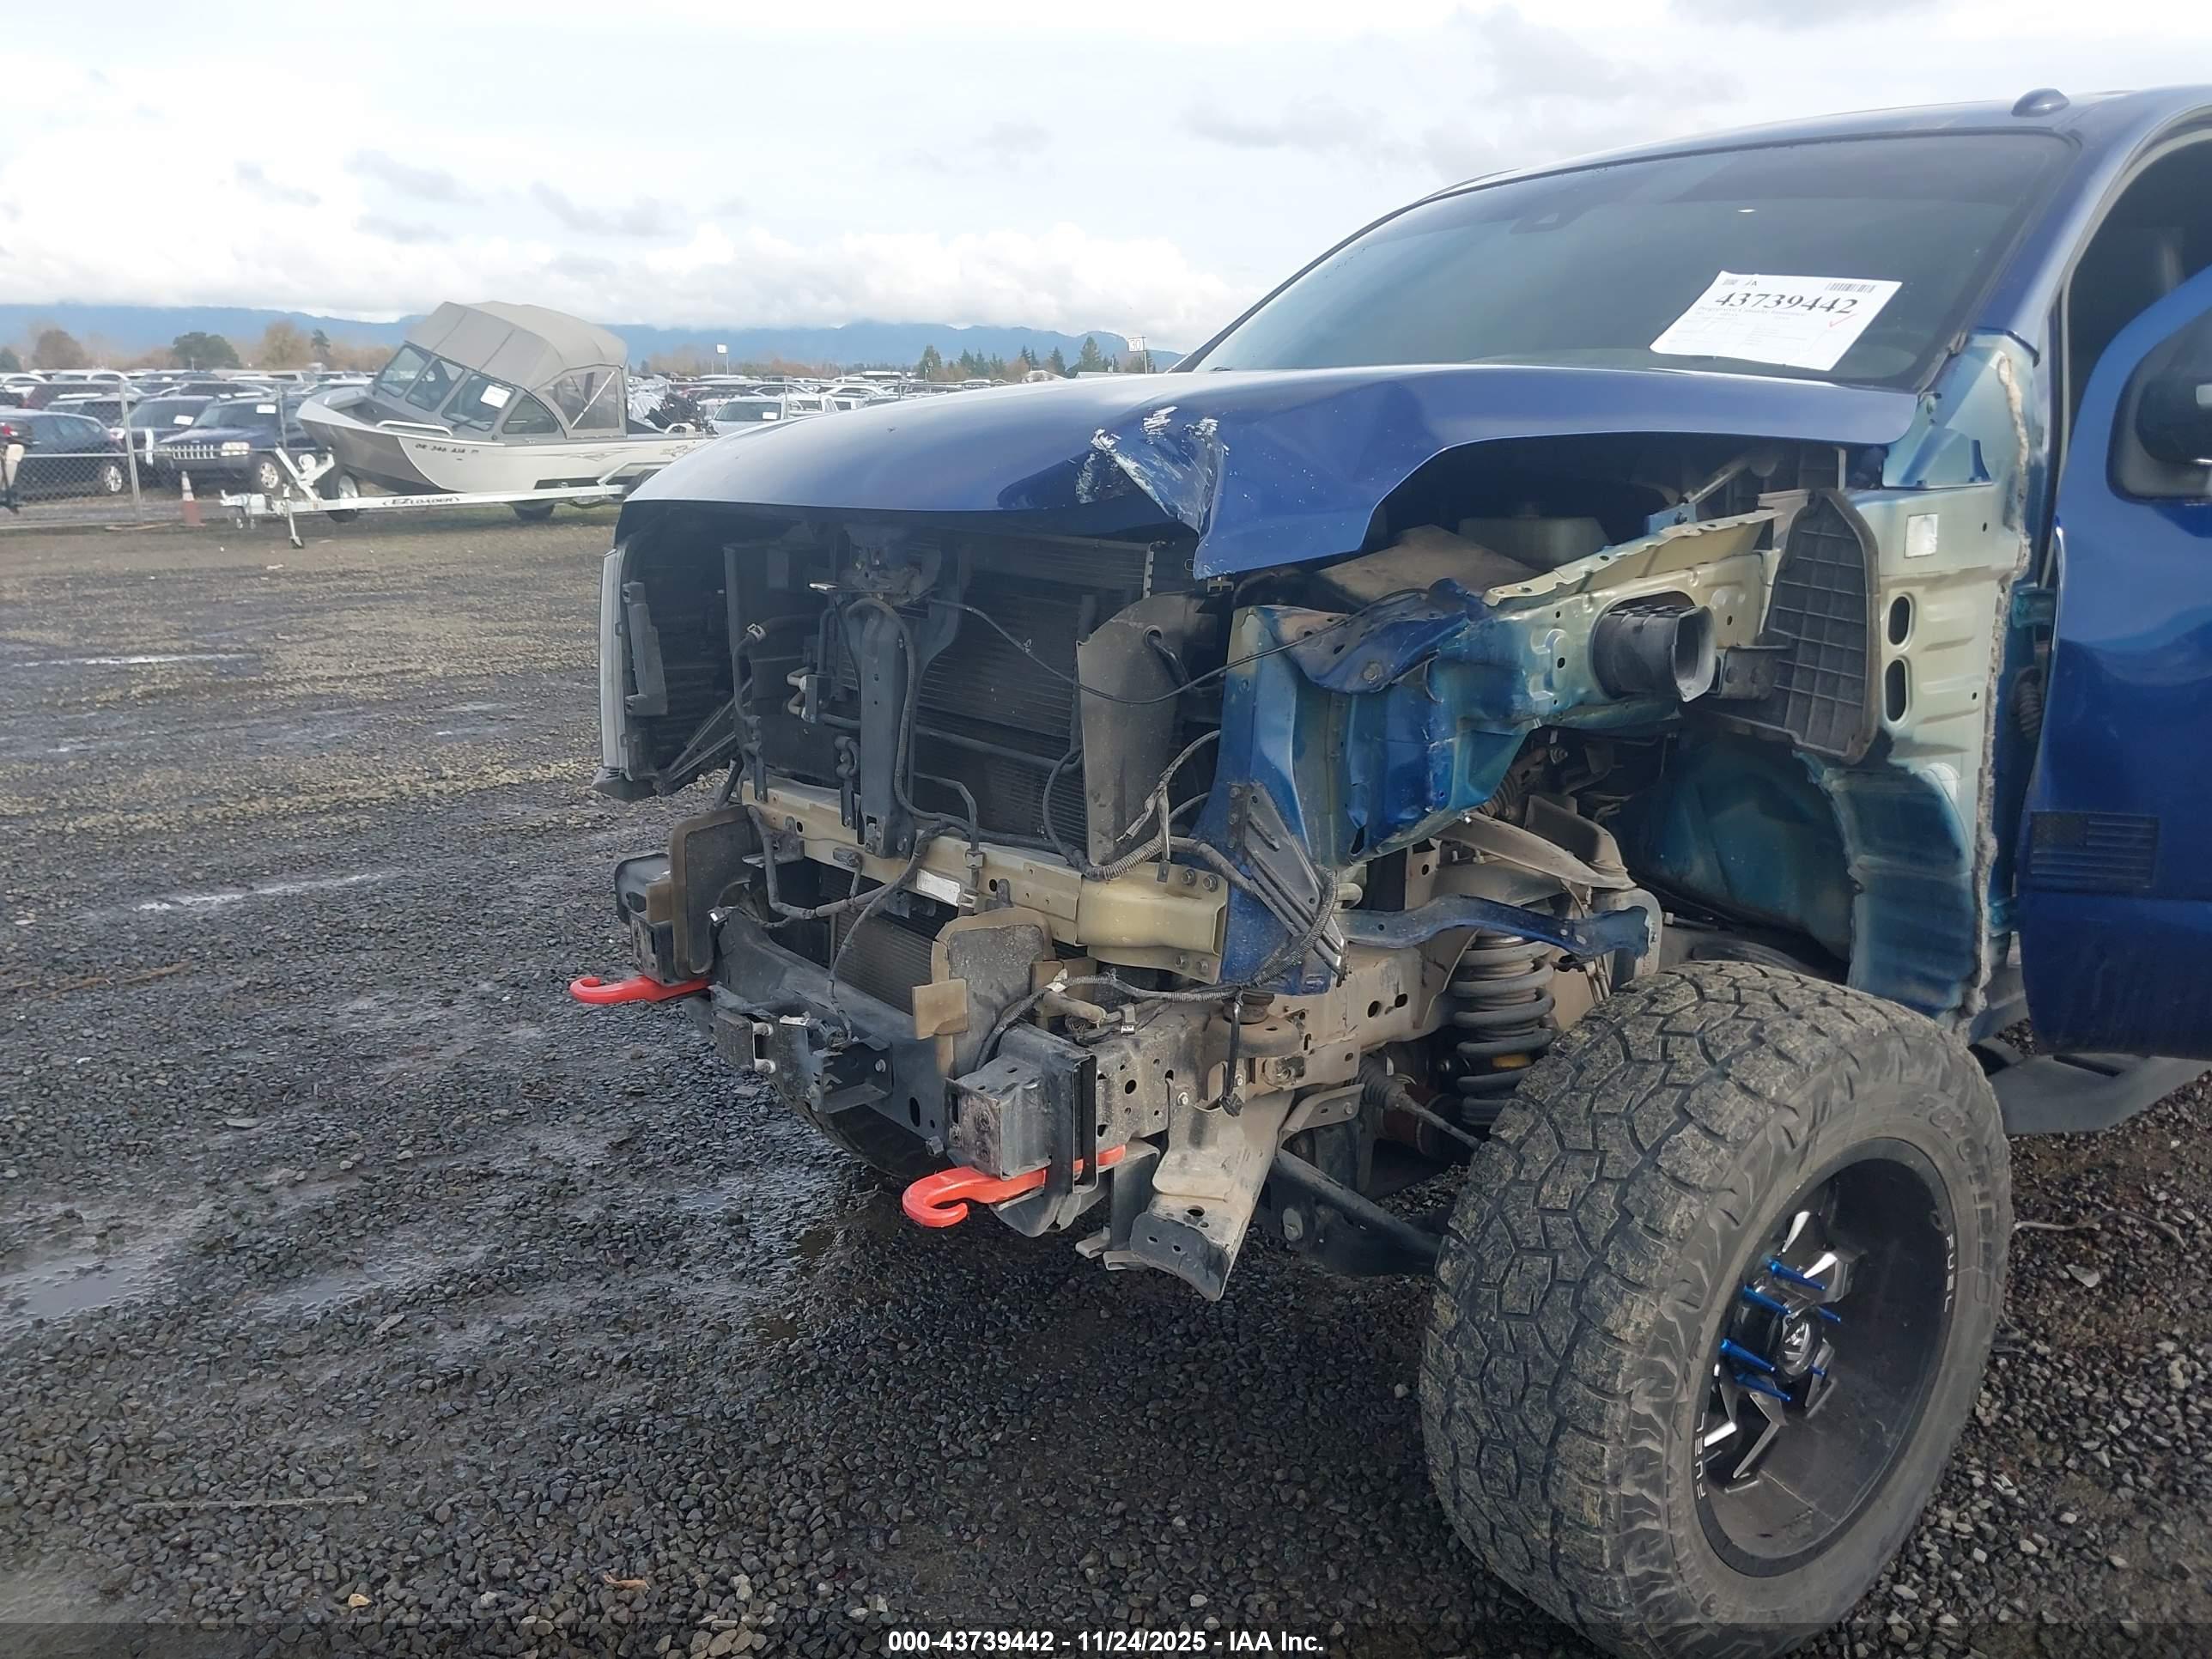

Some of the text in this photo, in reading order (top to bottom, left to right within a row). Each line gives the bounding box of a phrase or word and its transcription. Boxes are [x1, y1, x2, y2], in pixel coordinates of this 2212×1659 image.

[1716, 292, 1859, 313] 43739442
[1130, 339, 1141, 350] 30
[1943, 1233, 1955, 1313] FUEL
[1694, 1412, 1706, 1500] FUEL
